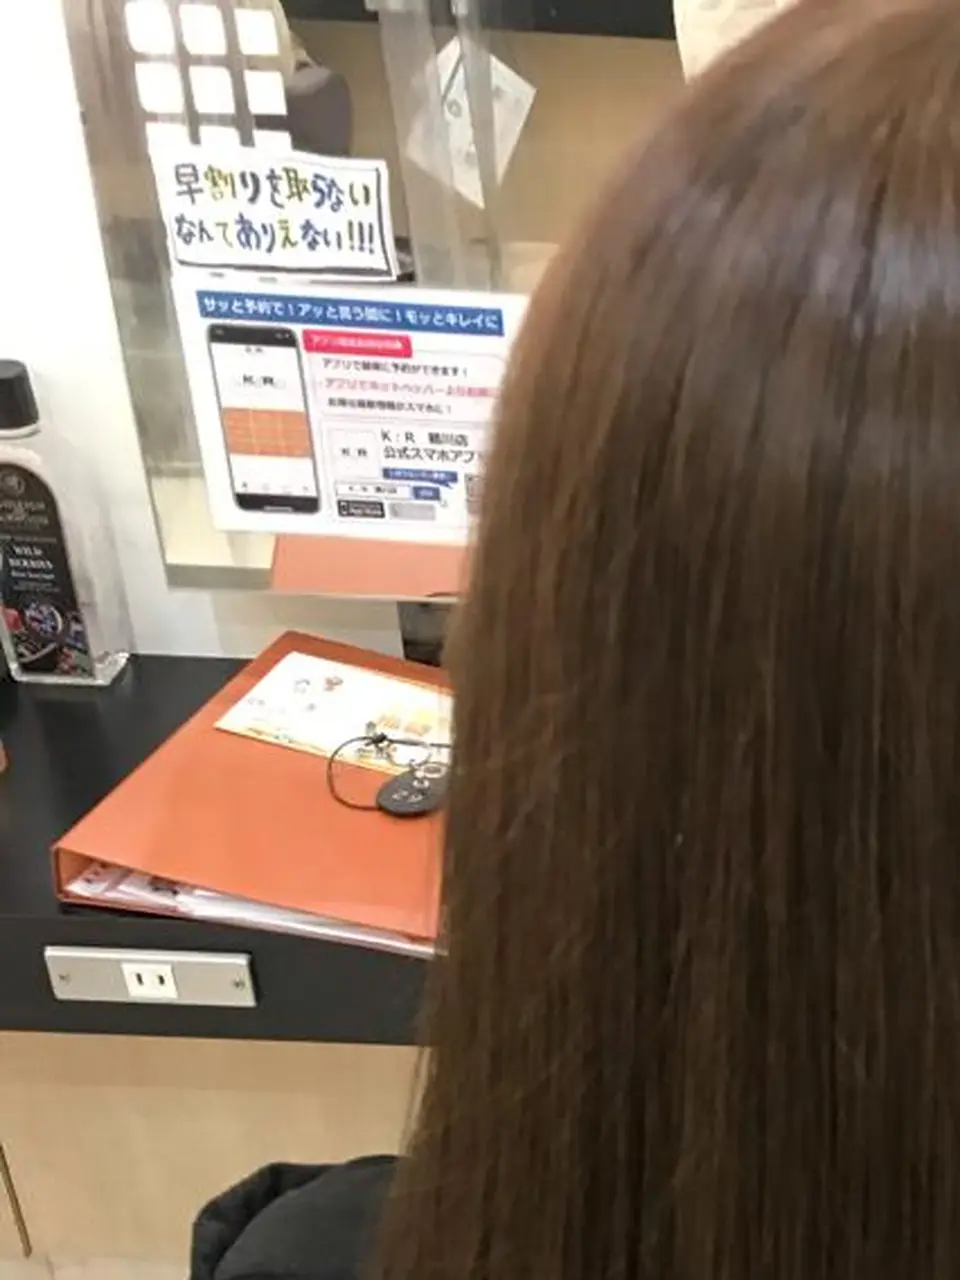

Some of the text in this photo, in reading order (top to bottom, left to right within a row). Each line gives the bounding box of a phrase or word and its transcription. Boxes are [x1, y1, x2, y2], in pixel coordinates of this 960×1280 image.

[174, 163, 371, 212] 早割りを取らない
